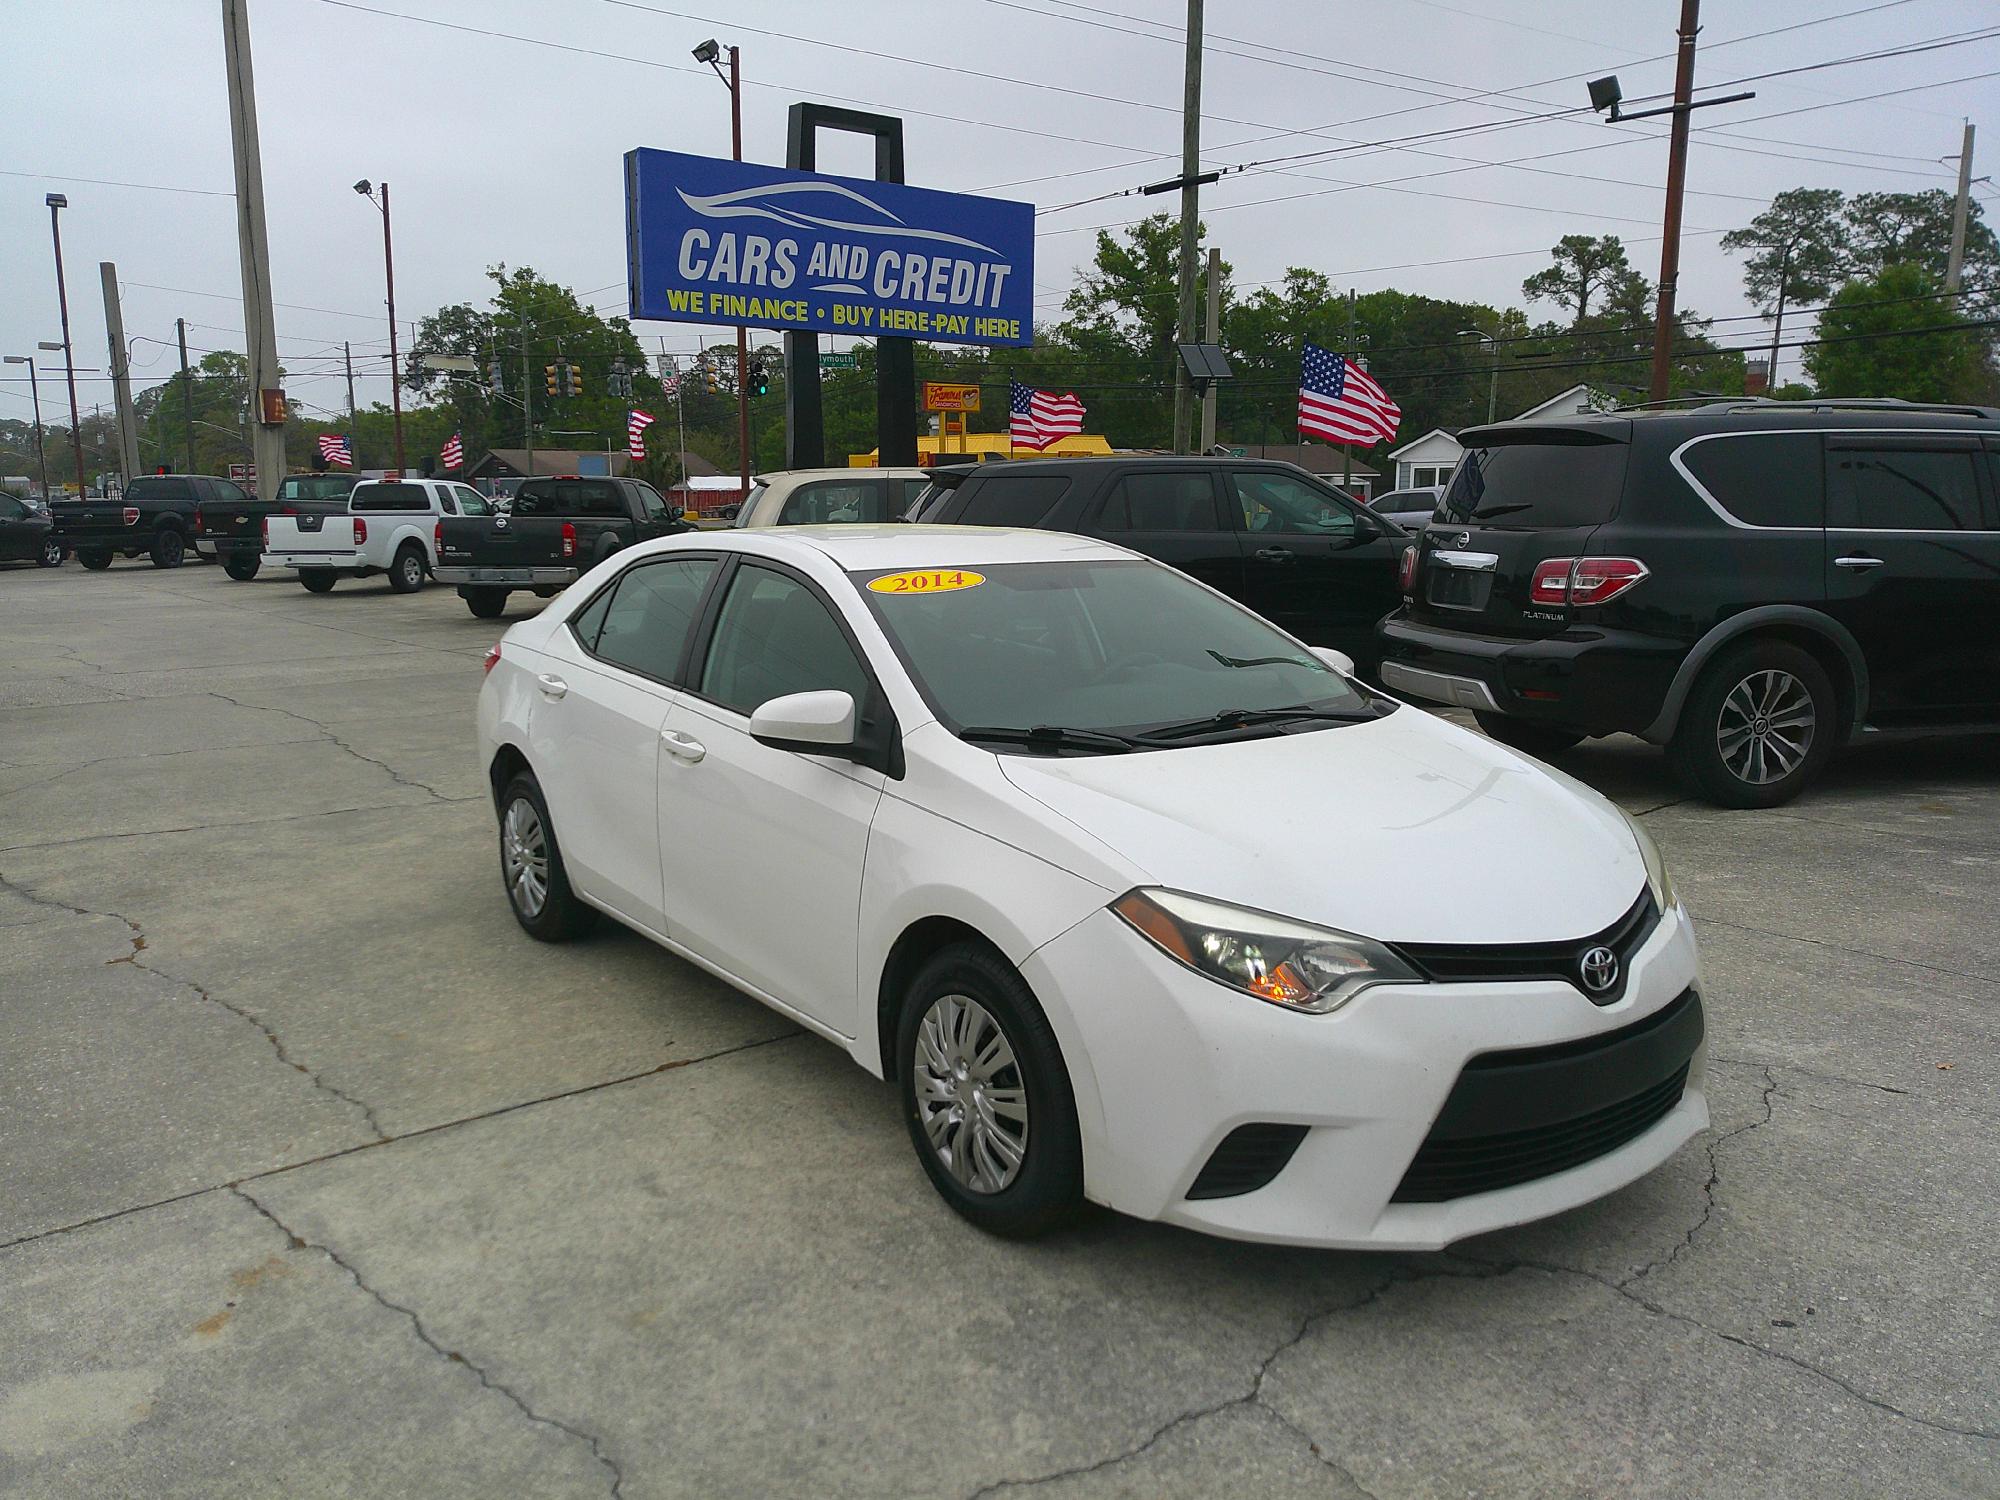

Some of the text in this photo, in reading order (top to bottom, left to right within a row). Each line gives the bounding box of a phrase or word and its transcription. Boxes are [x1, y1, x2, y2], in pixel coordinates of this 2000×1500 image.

[678, 228, 1012, 308] CARS AND CREDIT
[666, 289, 1020, 339] WE FINANCE BUY HERE-PAY HERE
[819, 354, 854, 363] lymouth
[892, 572, 965, 591] 2014
[1522, 610, 1565, 621] PLATINUM
